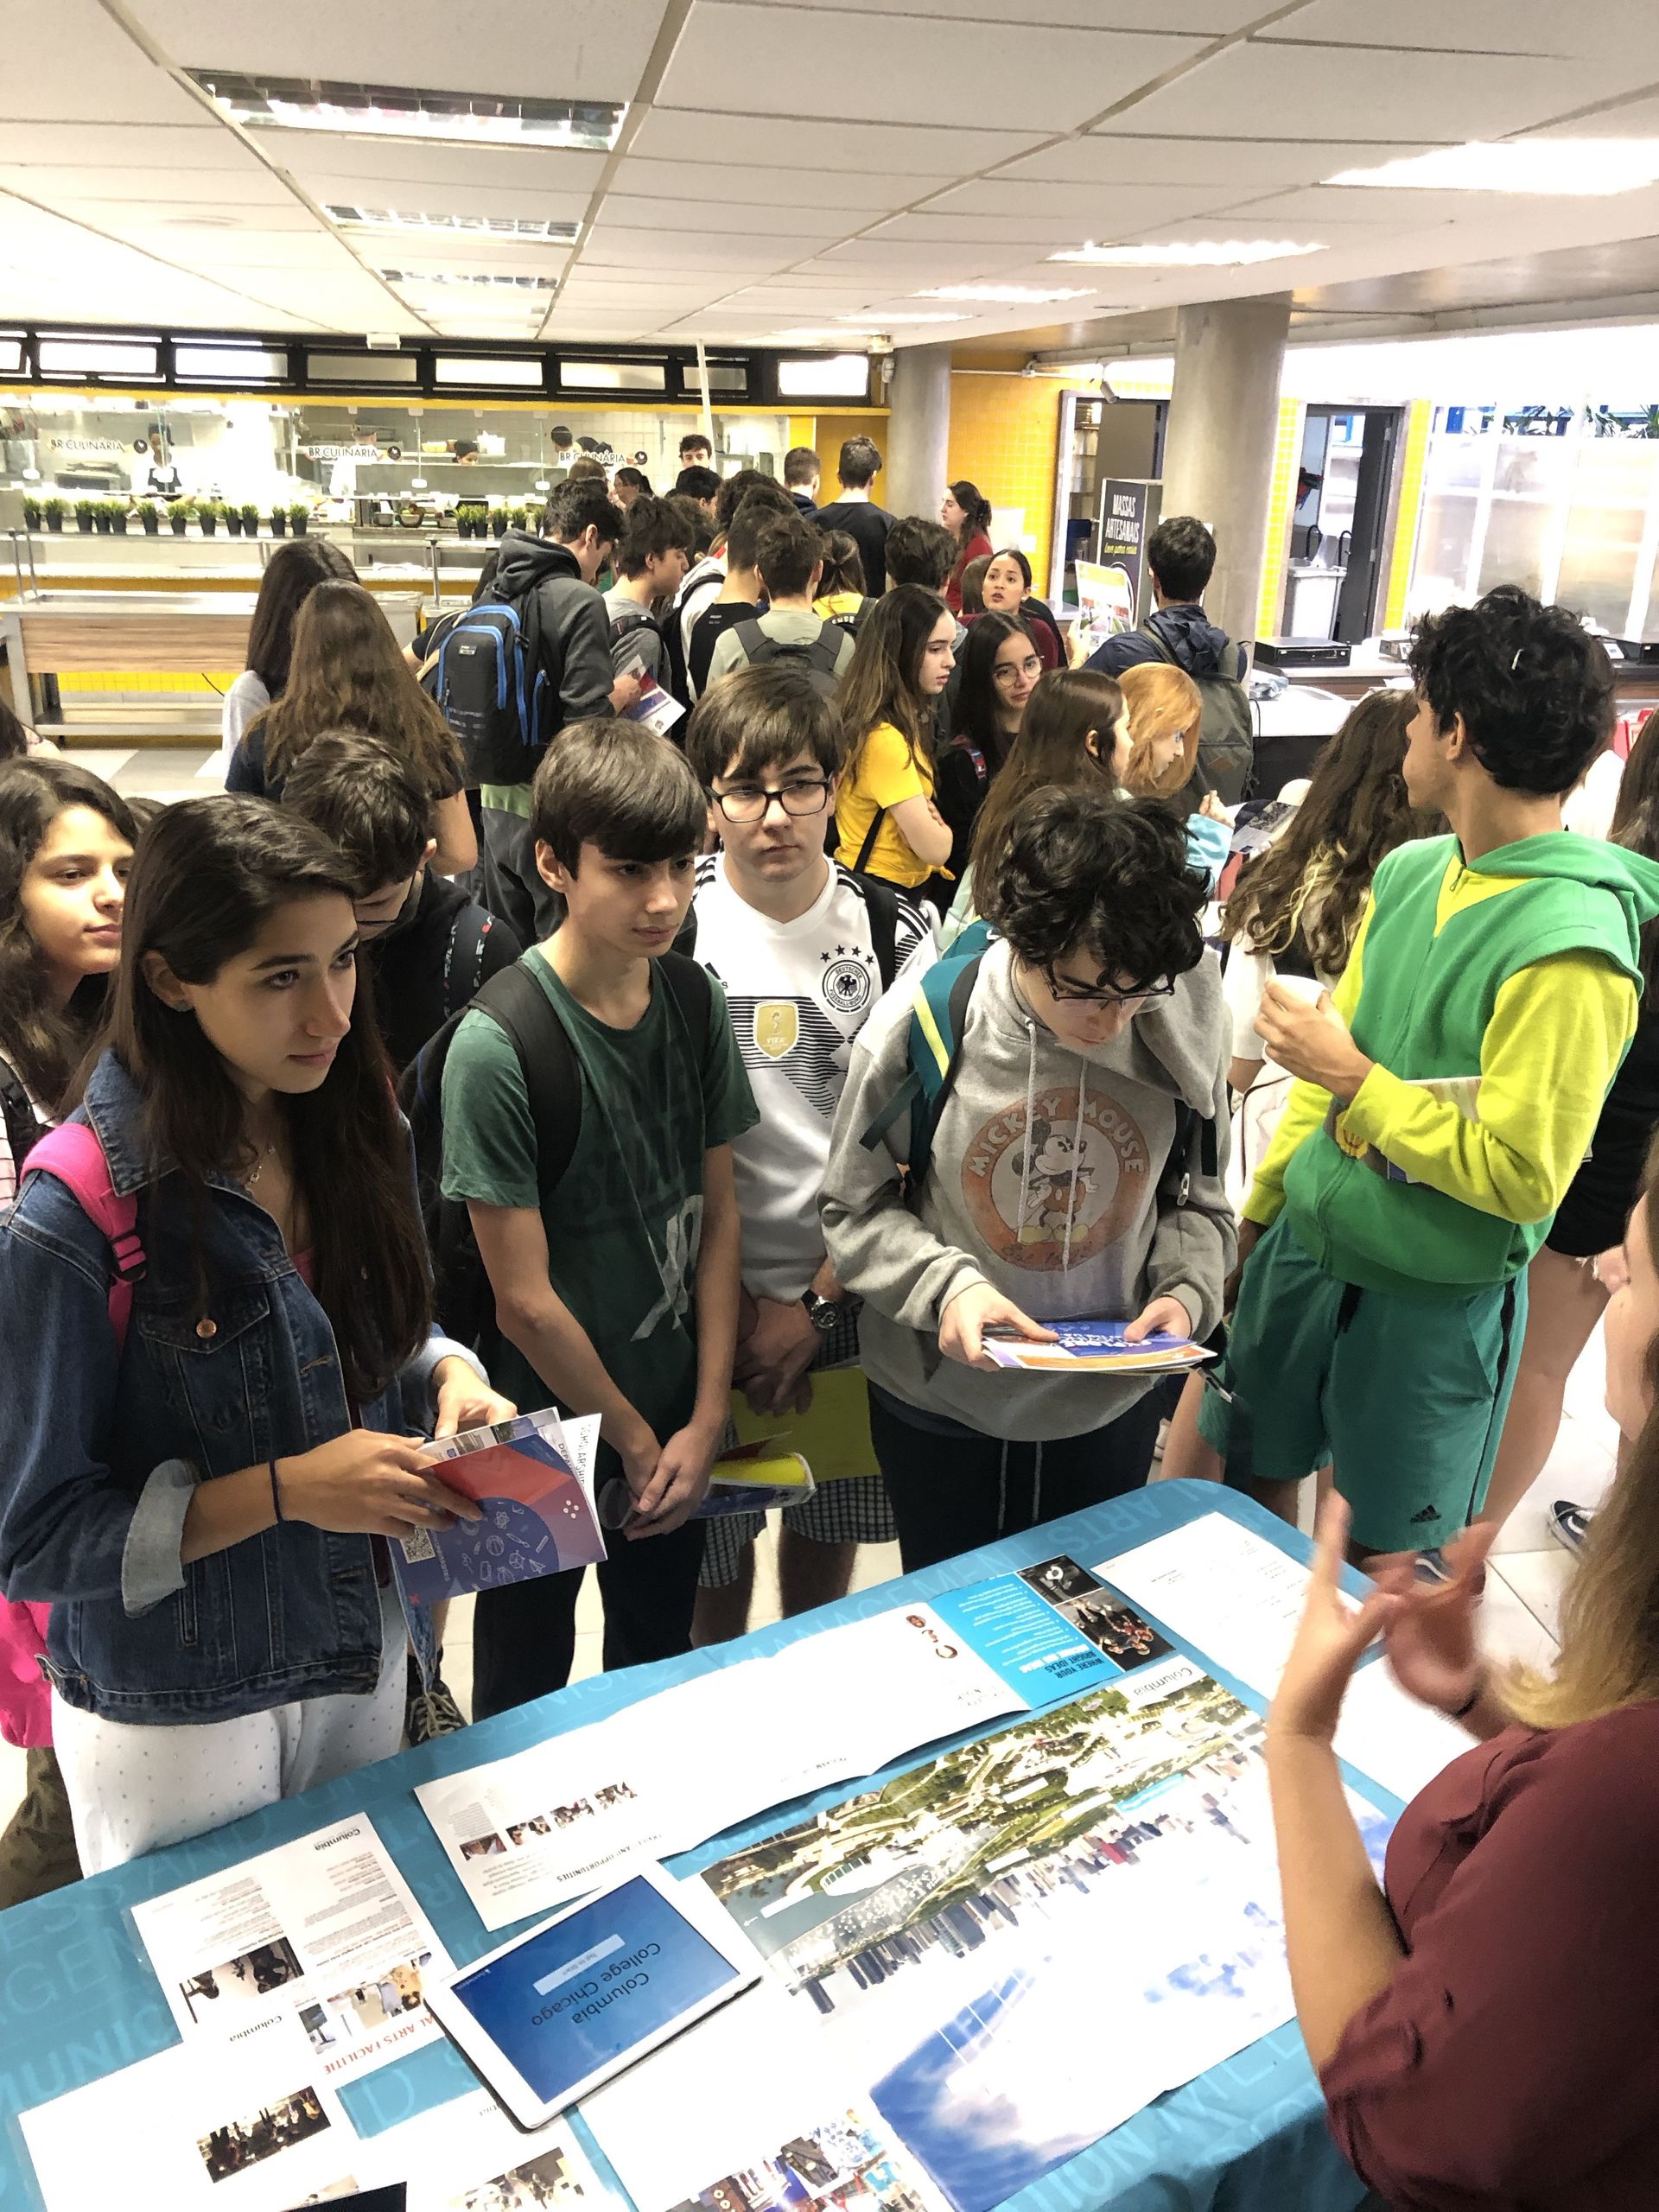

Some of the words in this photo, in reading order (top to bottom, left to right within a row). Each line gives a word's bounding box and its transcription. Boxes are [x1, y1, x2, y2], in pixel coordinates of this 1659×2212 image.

[308, 446, 321, 458] BR
[560, 451, 571, 461] BR
[1112, 493, 1137, 518] MASSAS
[1104, 518, 1141, 543] ARTESANAIS
[834, 965, 863, 980] DEUTSCHER
[1076, 1096, 1145, 1173] MOUSE
[1044, 1660, 1068, 1674] IDEAS
[1068, 1650, 1097, 1665] BRIGHT
[1076, 1656, 1106, 1671] WHERE
[1054, 1666, 1077, 1679] YOUR
[1133, 1667, 1194, 1697] Columbia
[315, 1827, 361, 1851] Columbia
[557, 1855, 614, 1884] OPPORTUNITIES
[601, 1942, 661, 1983] College
[531, 1980, 598, 2027] Chicago
[572, 1971, 650, 2025] Columbia
[229, 2015, 283, 2043] Columbia
[383, 2025, 417, 2047] ARTS
[325, 2041, 381, 2075] FACILITIE
